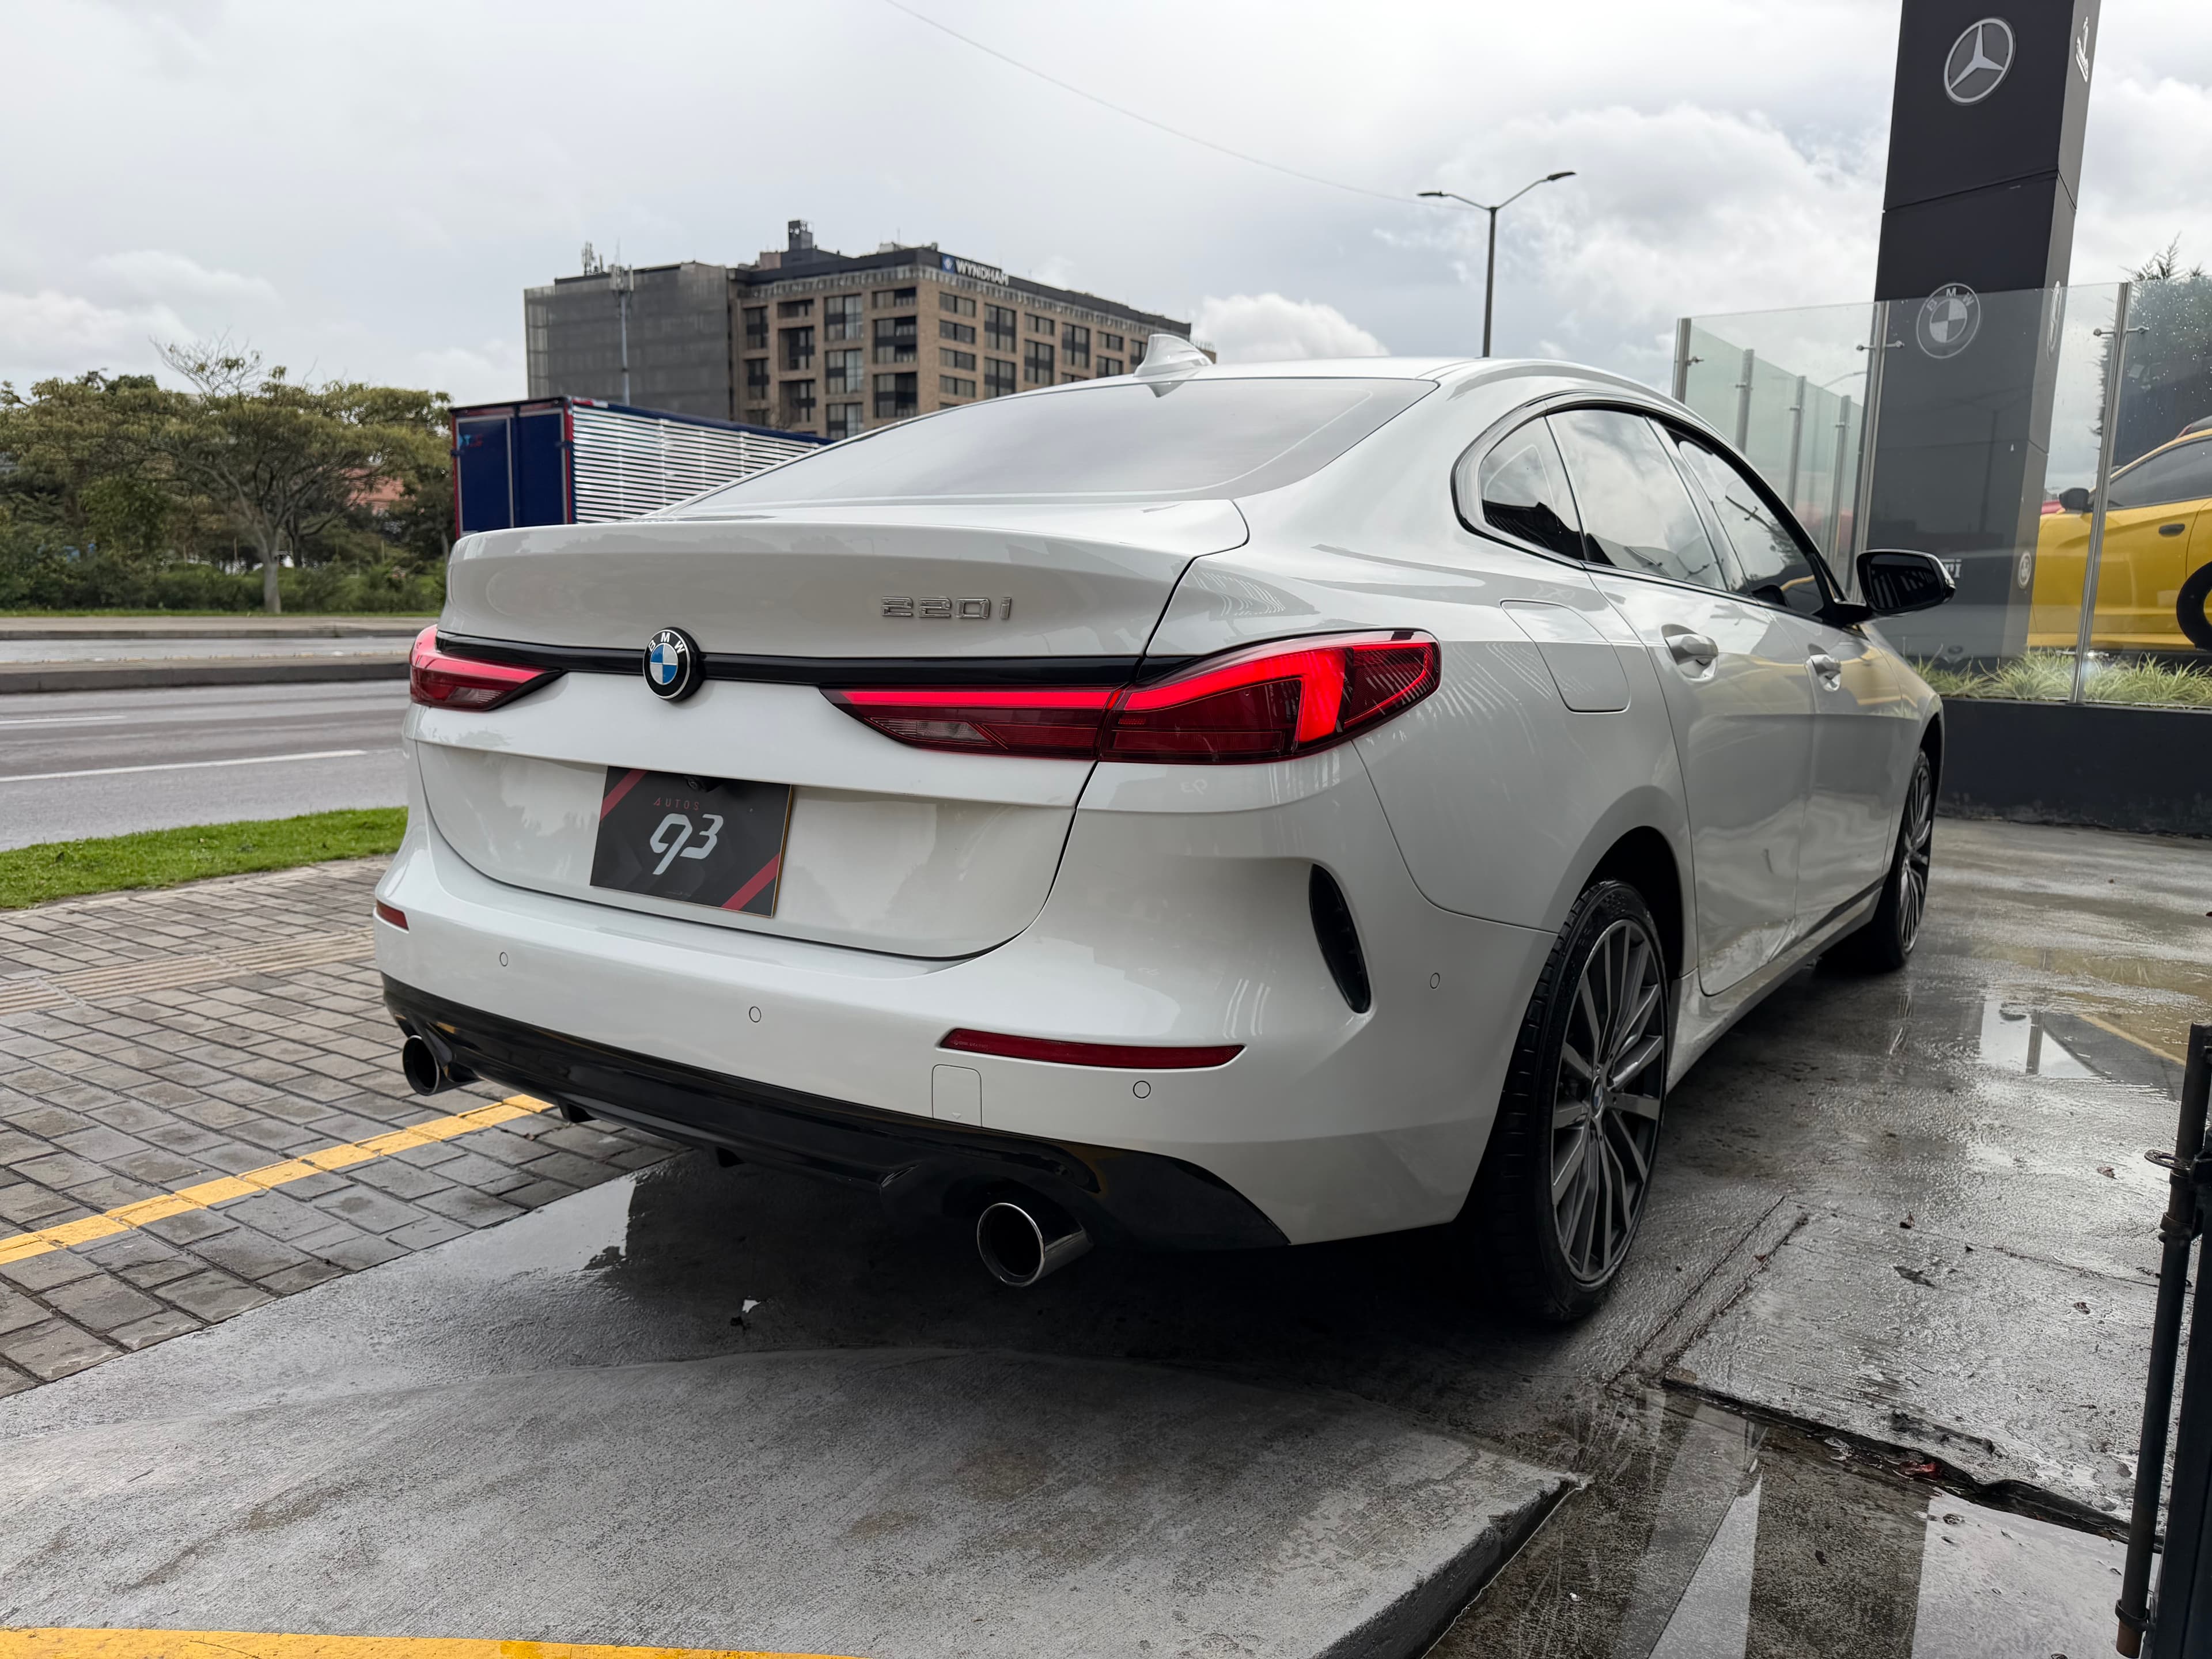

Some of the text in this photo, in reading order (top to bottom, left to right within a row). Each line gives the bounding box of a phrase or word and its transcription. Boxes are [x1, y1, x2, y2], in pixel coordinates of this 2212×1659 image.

[955, 259, 1009, 286] WYNDHAM
[1926, 287, 1975, 312] BMW
[880, 596, 1012, 620] 220i
[648, 632, 685, 654] BMW
[653, 797, 700, 811] AUTOS
[649, 813, 724, 876] 93
